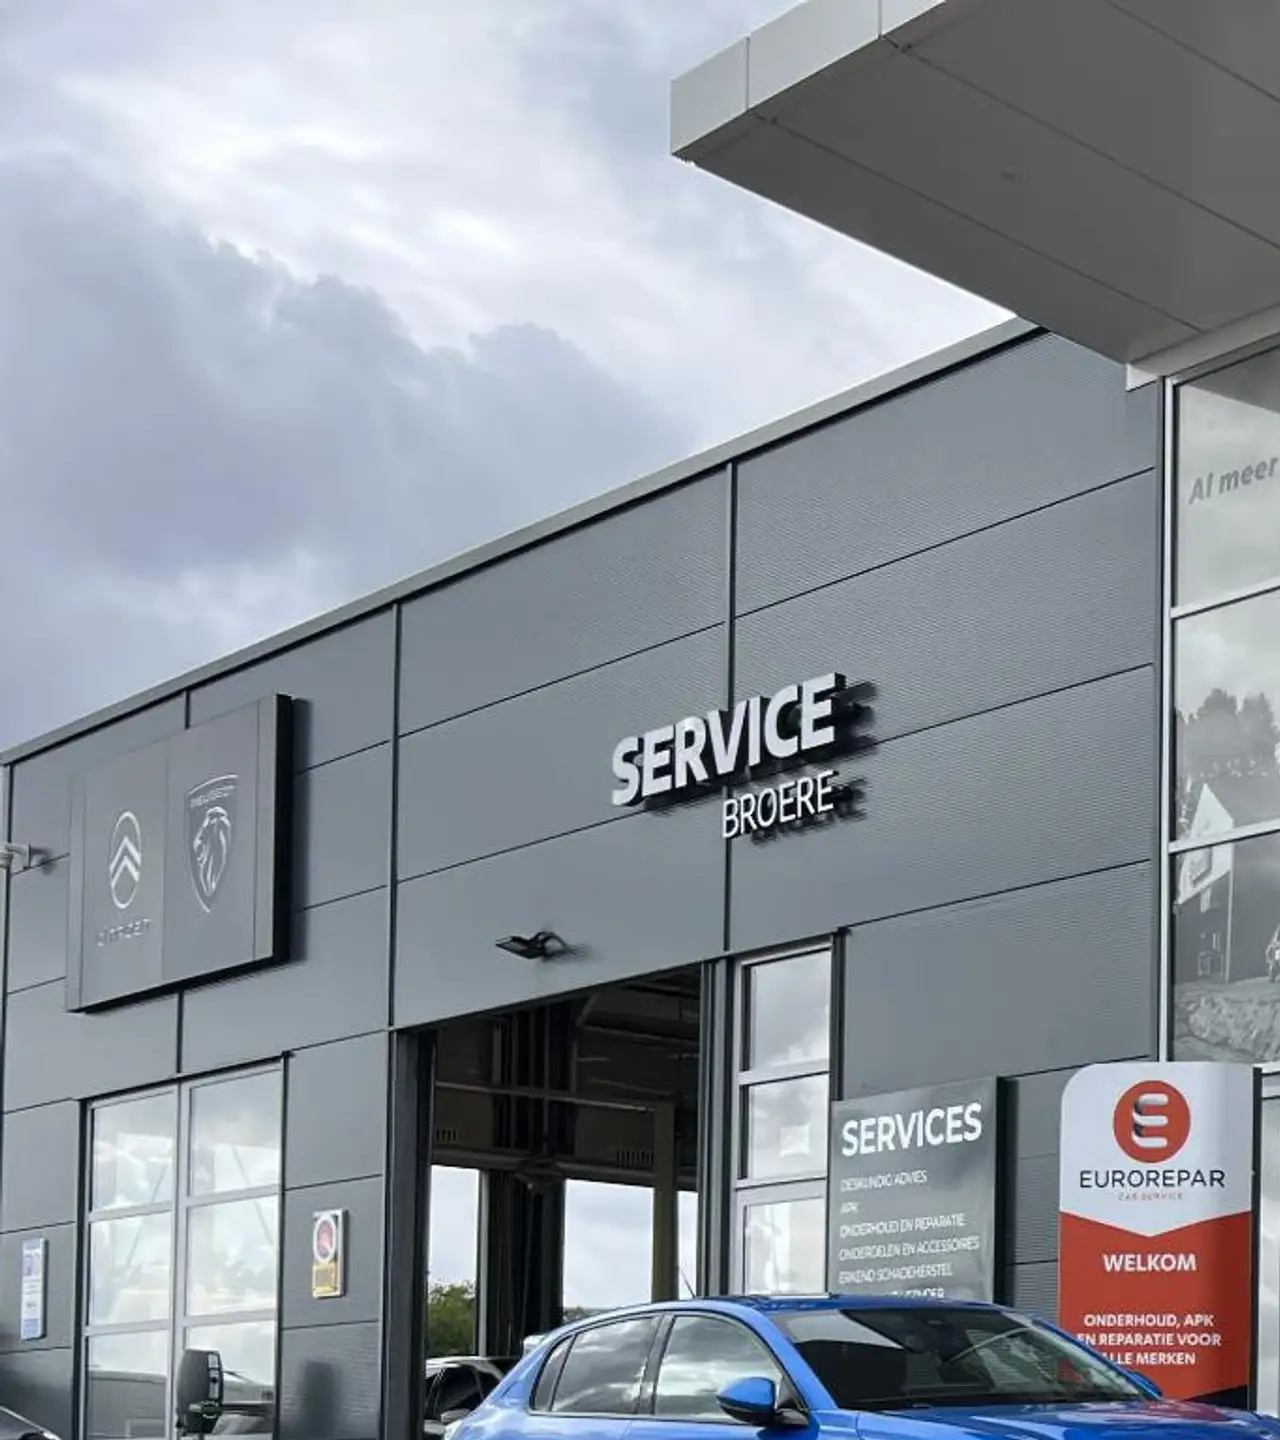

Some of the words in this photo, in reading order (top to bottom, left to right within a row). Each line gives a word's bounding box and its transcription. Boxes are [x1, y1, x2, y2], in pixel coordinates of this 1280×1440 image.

[1189, 475, 1214, 504] Al
[1218, 462, 1276, 495] meer
[612, 671, 838, 807] SERVICE
[721, 768, 837, 838] BROERE
[841, 1102, 983, 1157] SERVICES
[1079, 1169, 1226, 1189] EUROREPAR
[840, 1221, 899, 1239] ONDERHOUD
[900, 1219, 913, 1233] EN
[914, 1213, 966, 1232] REPARATIE
[839, 1244, 901, 1261] ONDERDELEN
[902, 1243, 915, 1256] EN
[917, 1236, 980, 1254] ACCESSOIRES
[1103, 1254, 1197, 1273] WELKOM
[839, 1269, 876, 1284] ERKEND
[1083, 1314, 1181, 1329] ONDERHOUD,
[1184, 1314, 1215, 1327] APK
[1098, 1333, 1175, 1346] REPARATIE
[1178, 1333, 1222, 1346] VOOR
[1136, 1352, 1196, 1365] MERKEN
